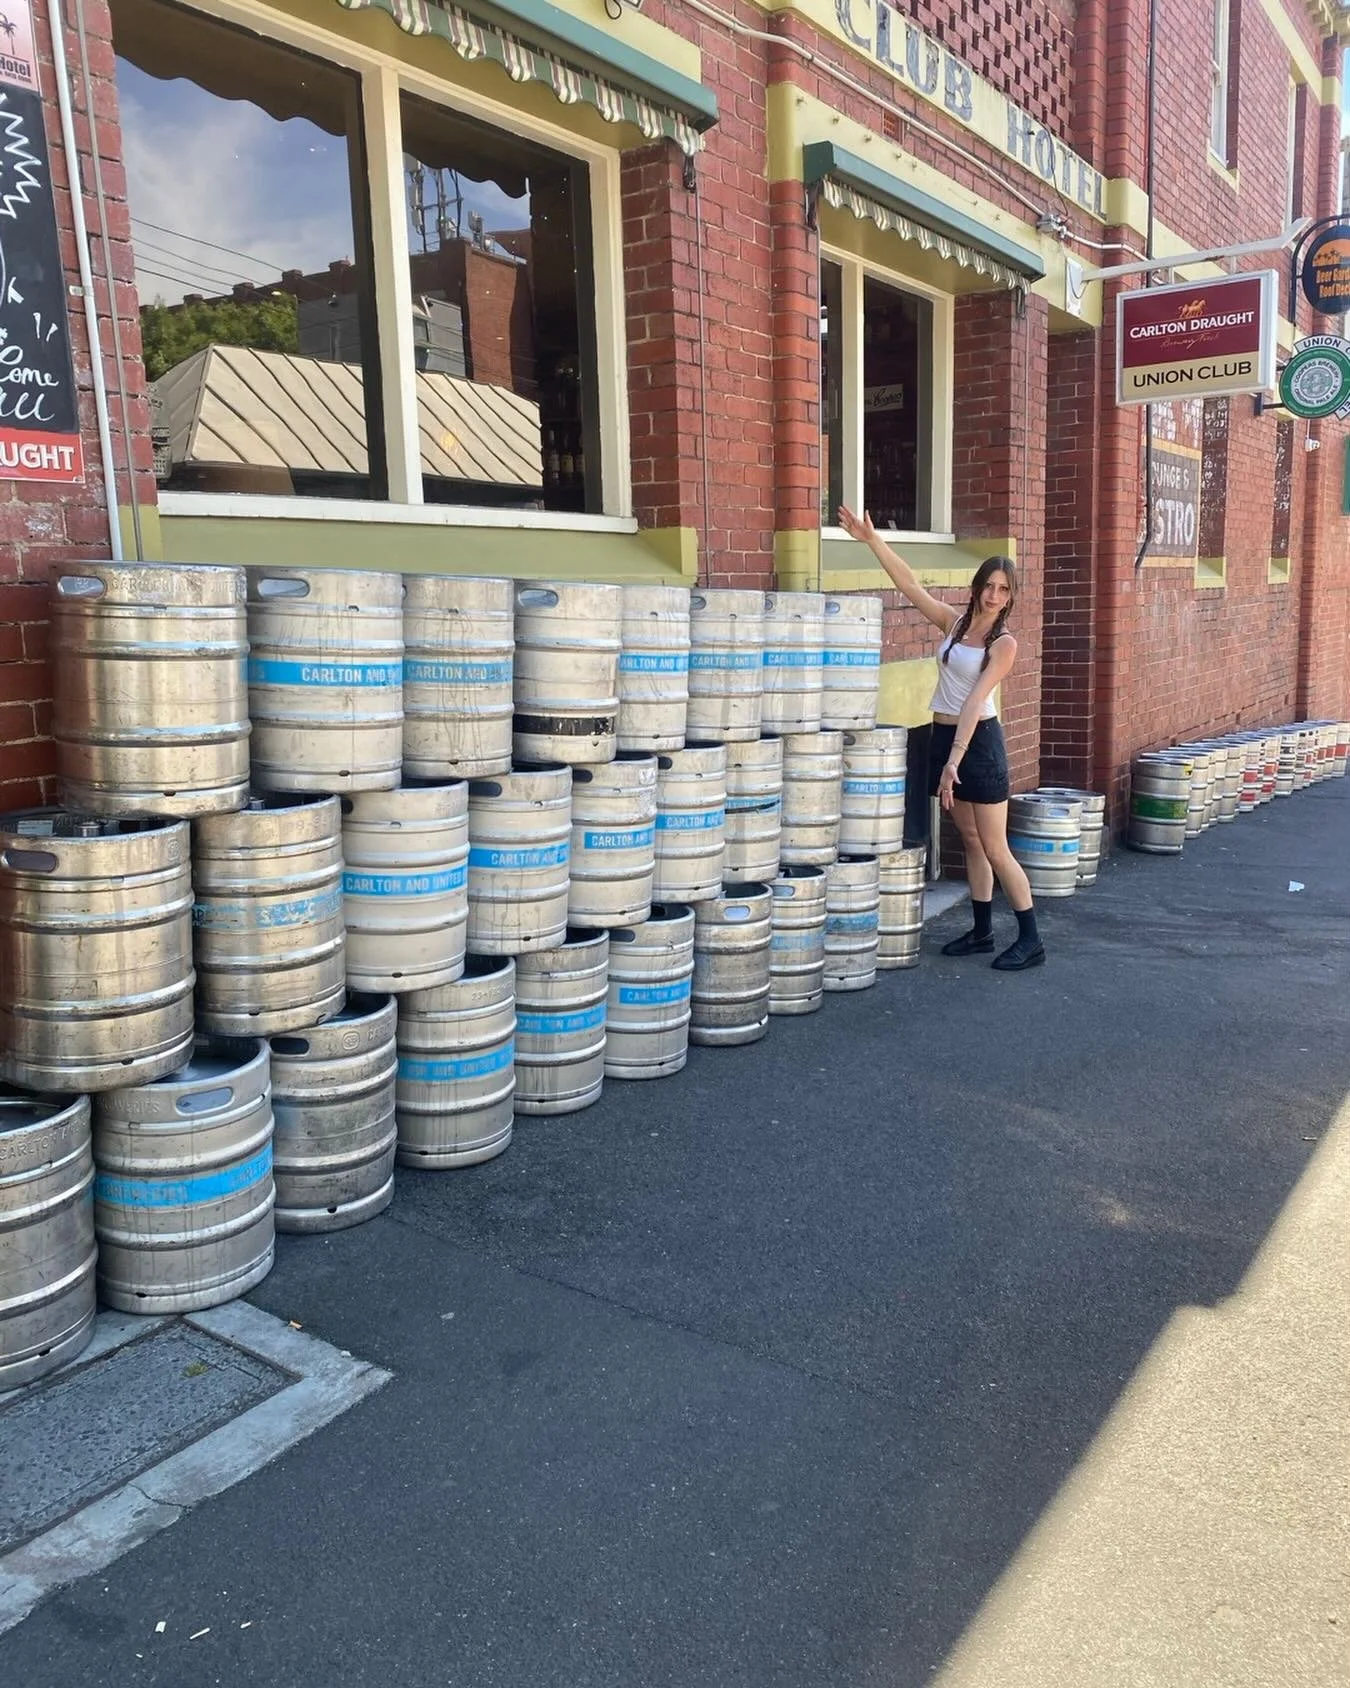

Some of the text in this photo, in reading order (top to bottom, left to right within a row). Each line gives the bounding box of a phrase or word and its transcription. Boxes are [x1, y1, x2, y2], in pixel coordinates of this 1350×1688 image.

[835, 0, 1106, 218] CLUB HOTEL
[1130, 310, 1255, 339] CARLTON DRAUGHT
[1303, 337, 1341, 348] UNION
[1133, 361, 1252, 388] UNION CLUB
[0, 441, 75, 470] UGHT
[660, 659, 674, 669] AND
[302, 667, 362, 682] CARLTON
[366, 669, 385, 683] AND
[407, 665, 462, 680] CARLTON
[666, 814, 705, 828] CARLTON
[591, 833, 634, 848] CARLTON
[491, 851, 540, 866] CARLTON
[345, 871, 462, 892] CARLTON AND UNITED
